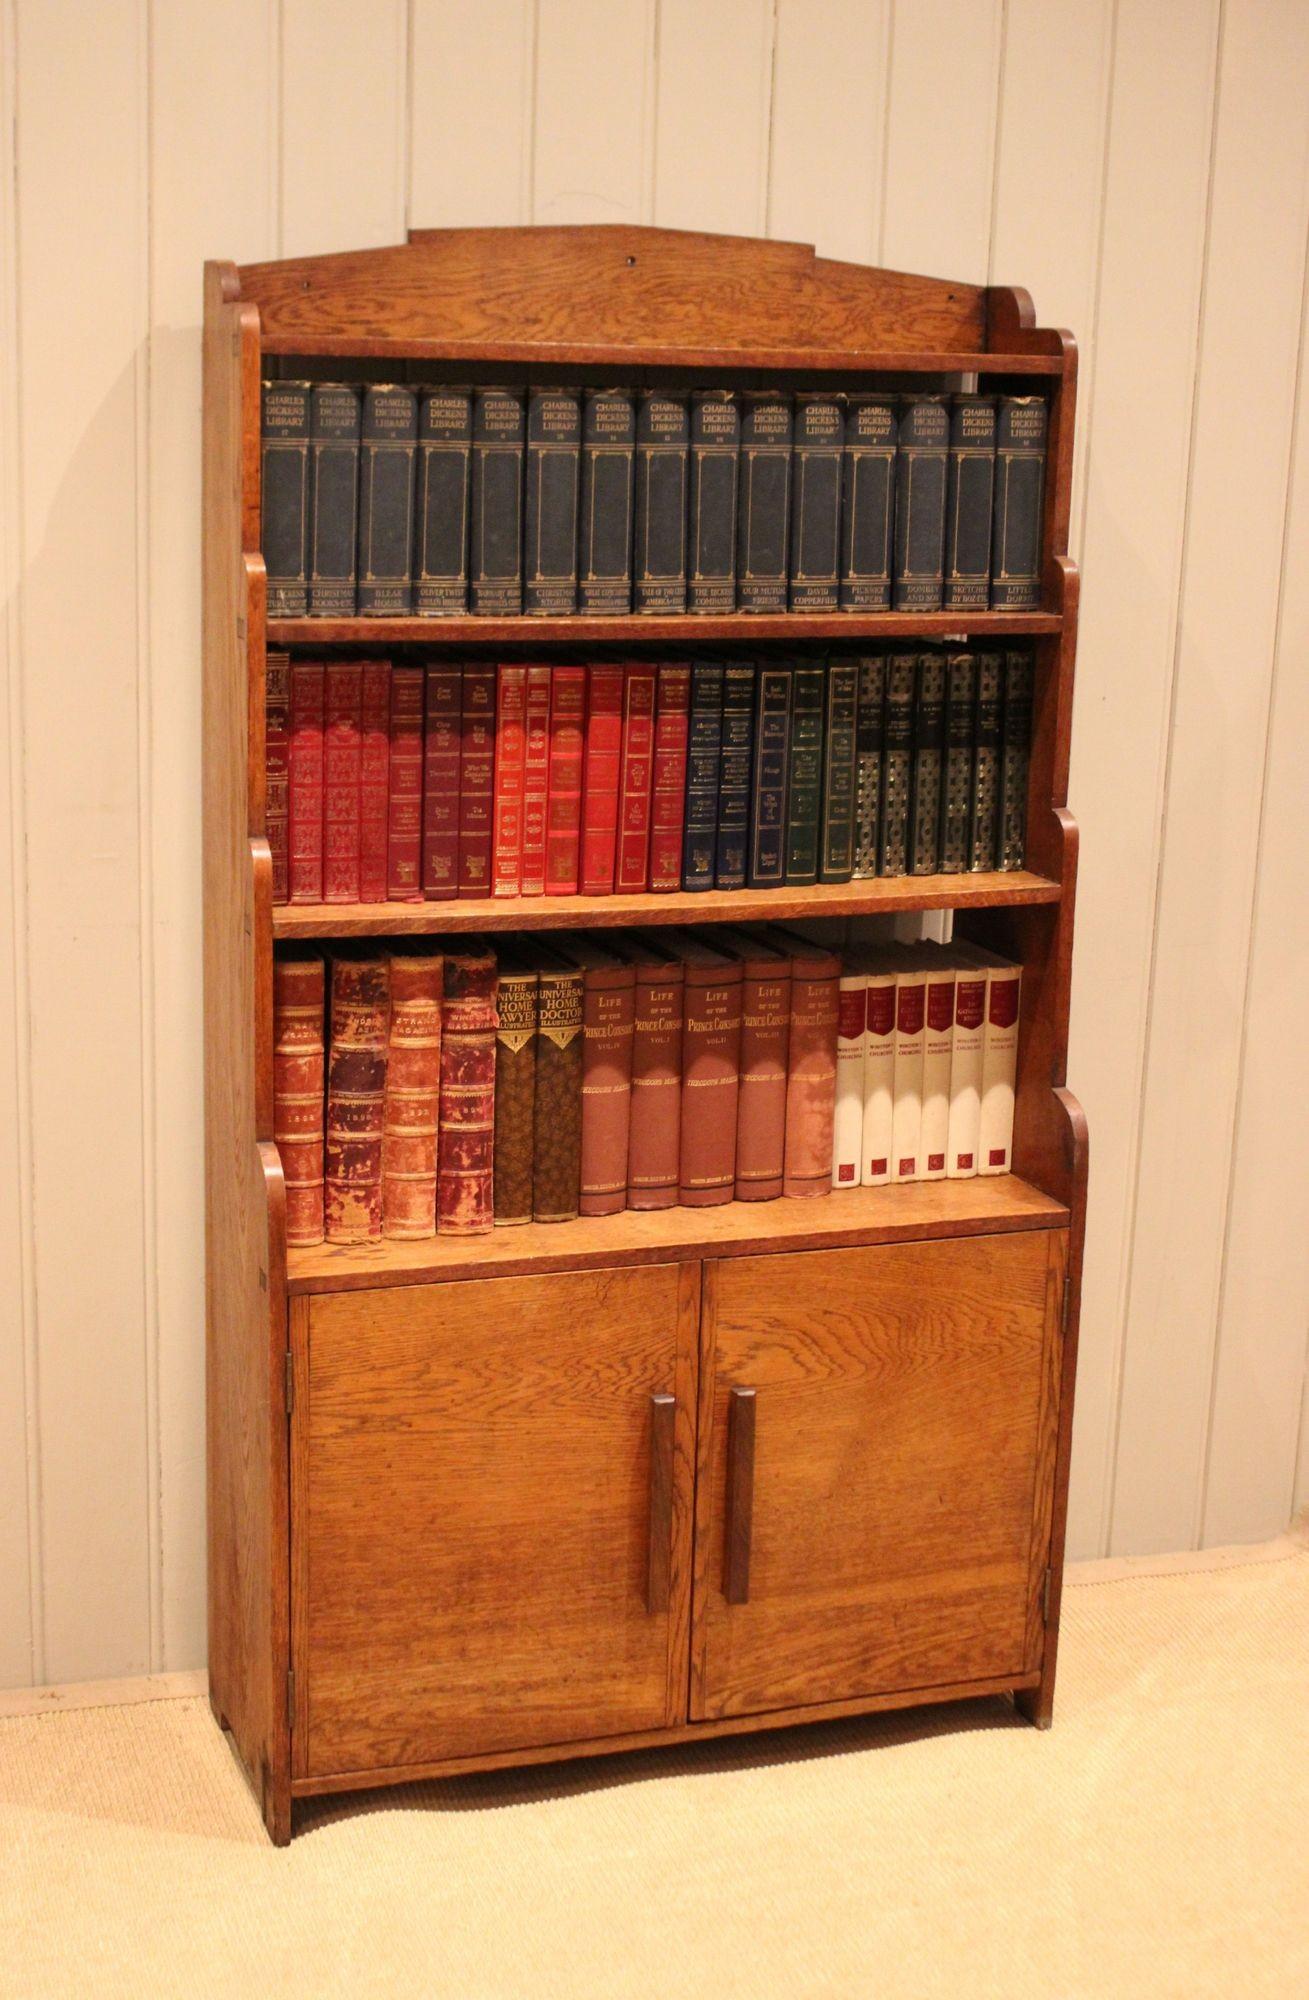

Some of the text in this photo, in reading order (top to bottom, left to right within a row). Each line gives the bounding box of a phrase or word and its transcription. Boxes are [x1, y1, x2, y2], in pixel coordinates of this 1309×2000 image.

[508, 984, 527, 992] THE
[555, 981, 573, 990] THE
[498, 991, 538, 1001] NIVERSA
[650, 990, 675, 1001] LIFE
[706, 991, 728, 1001] LIFE
[500, 1001, 533, 1012] HOME
[547, 998, 579, 1010] HOME
[500, 1011, 537, 1023] AWYER
[540, 1008, 583, 1020] DOCTOR
[688, 1018, 713, 1032] PRINCE
